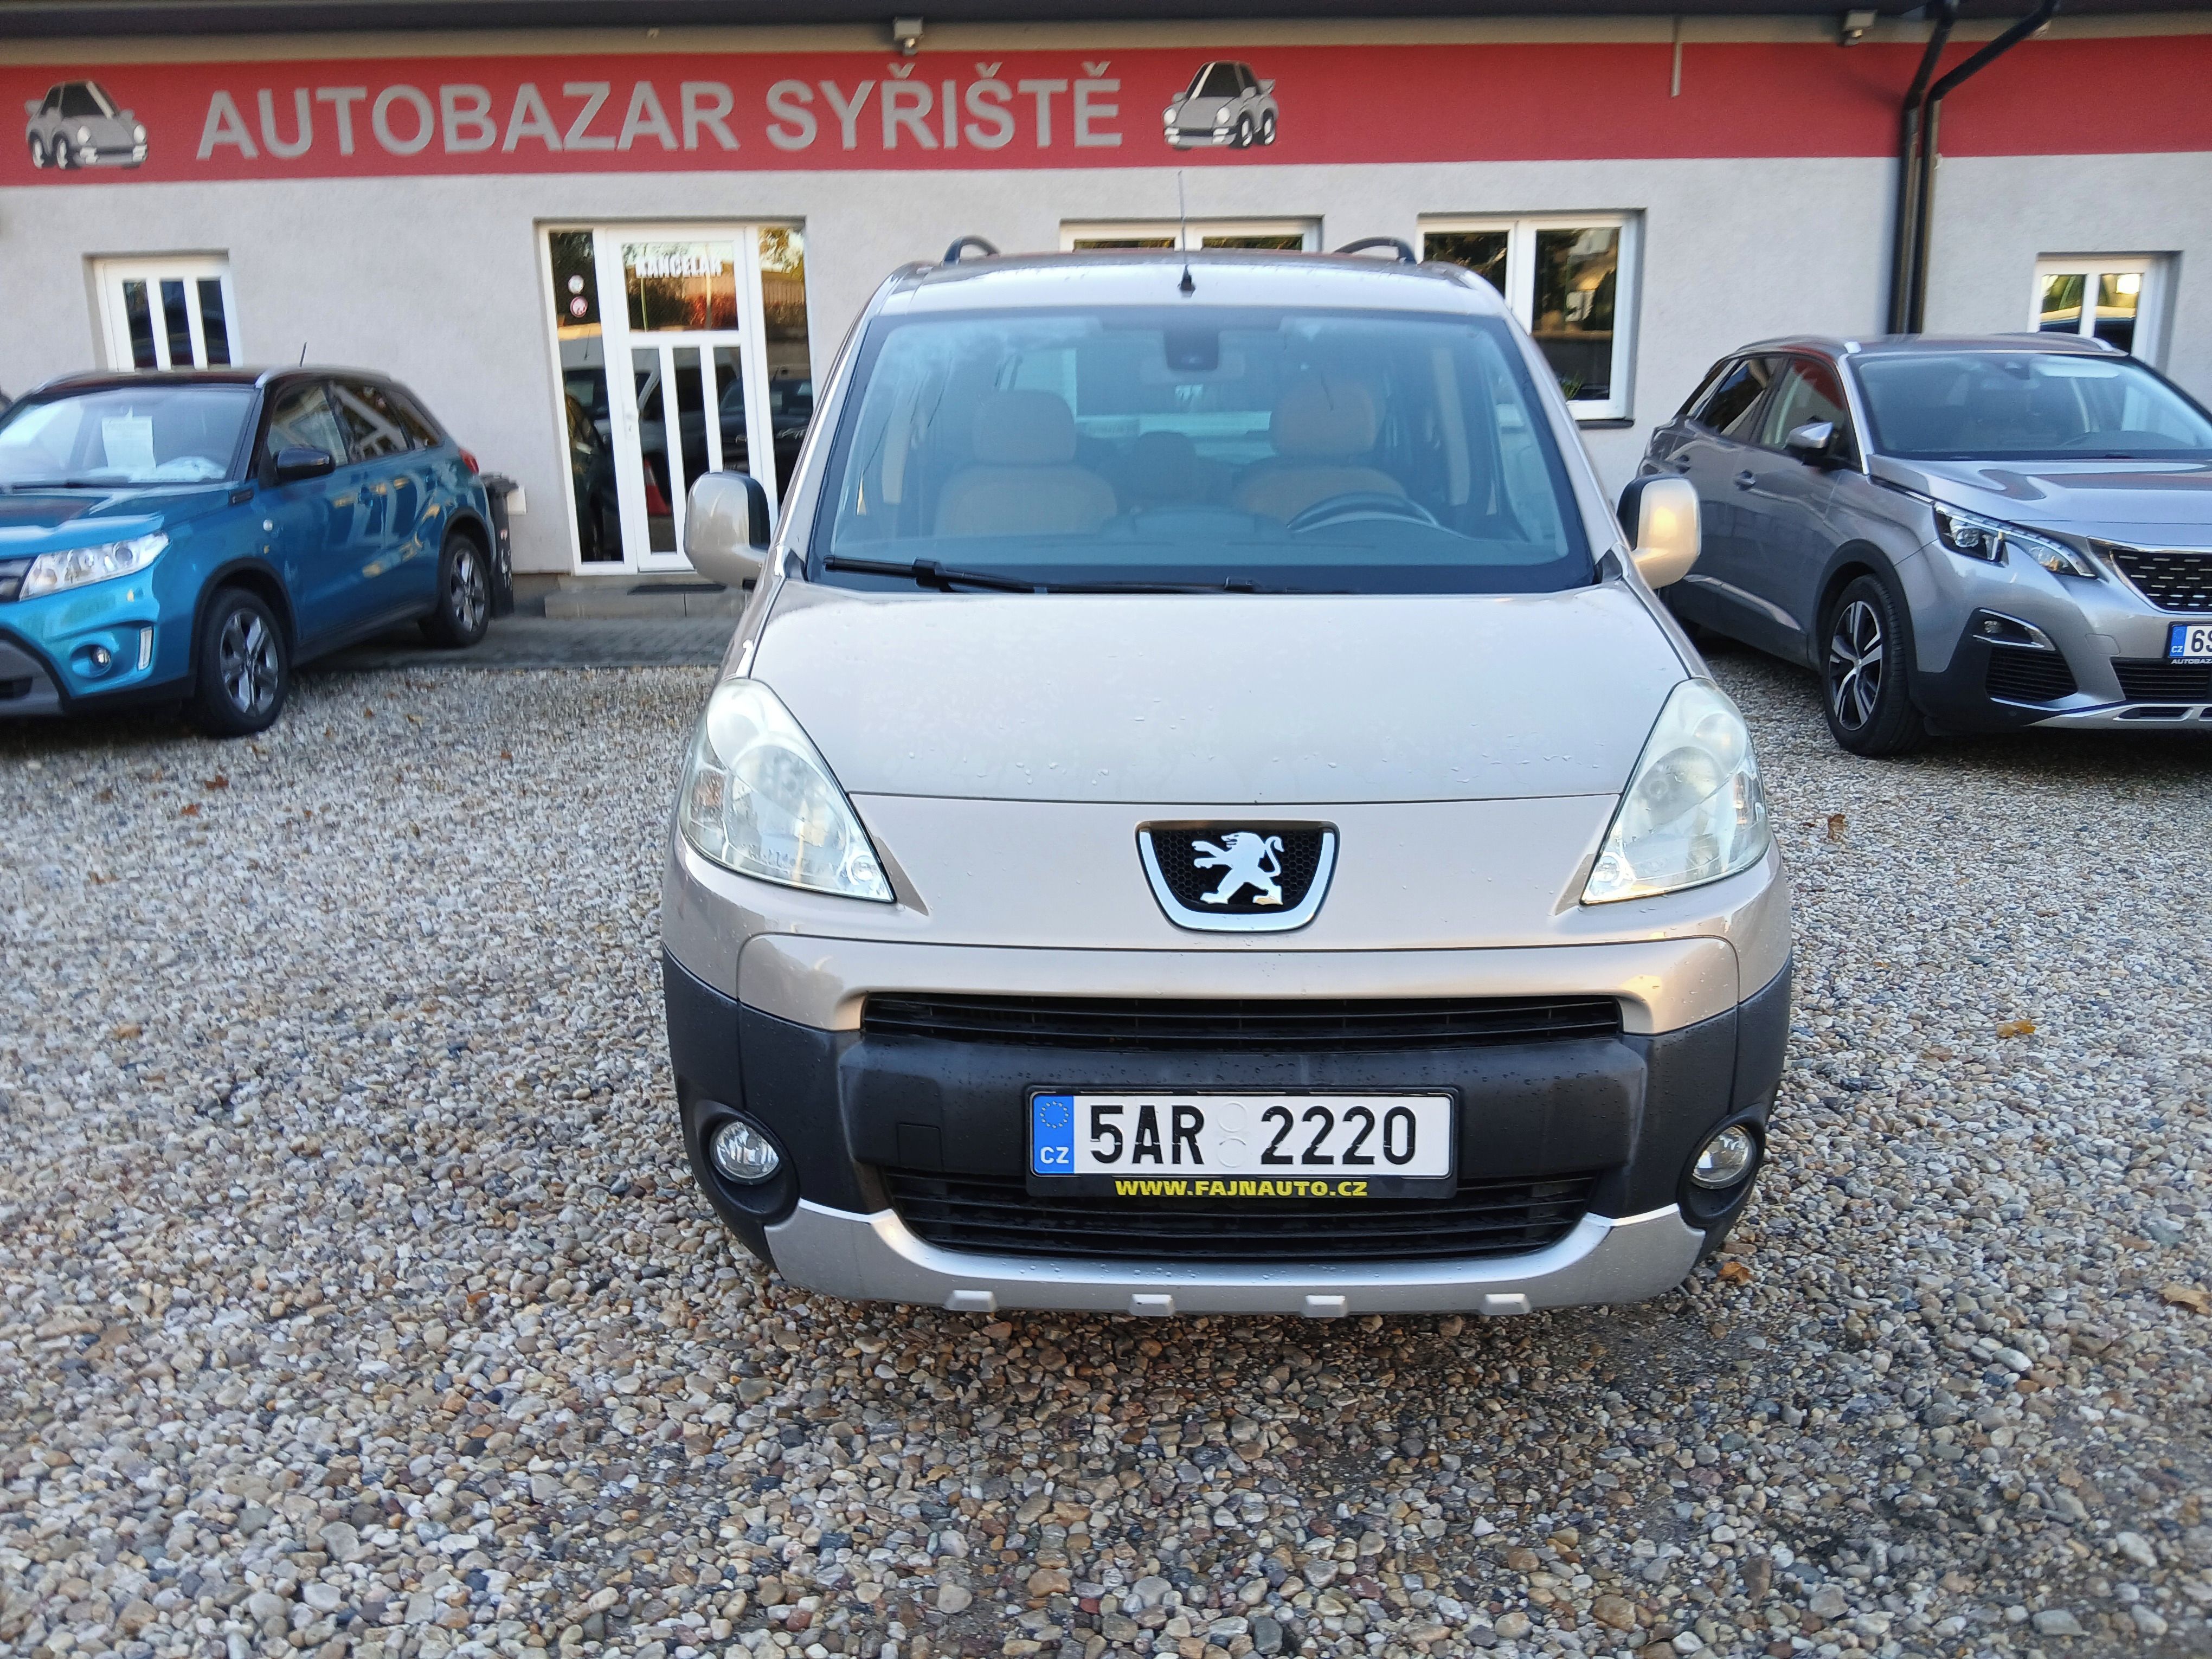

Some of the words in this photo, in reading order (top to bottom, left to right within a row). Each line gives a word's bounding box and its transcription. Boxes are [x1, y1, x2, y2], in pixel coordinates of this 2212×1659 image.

[196, 81, 741, 160] AUTOBAZAR
[765, 61, 1123, 151] SYŘIŠTĚ
[1090, 1105, 1205, 1164] 5AR
[1261, 1105, 1416, 1165] 2220
[1040, 1146, 1070, 1164] CZ
[1115, 1181, 1368, 1197] WWW.FAJNAUTO.CZ
